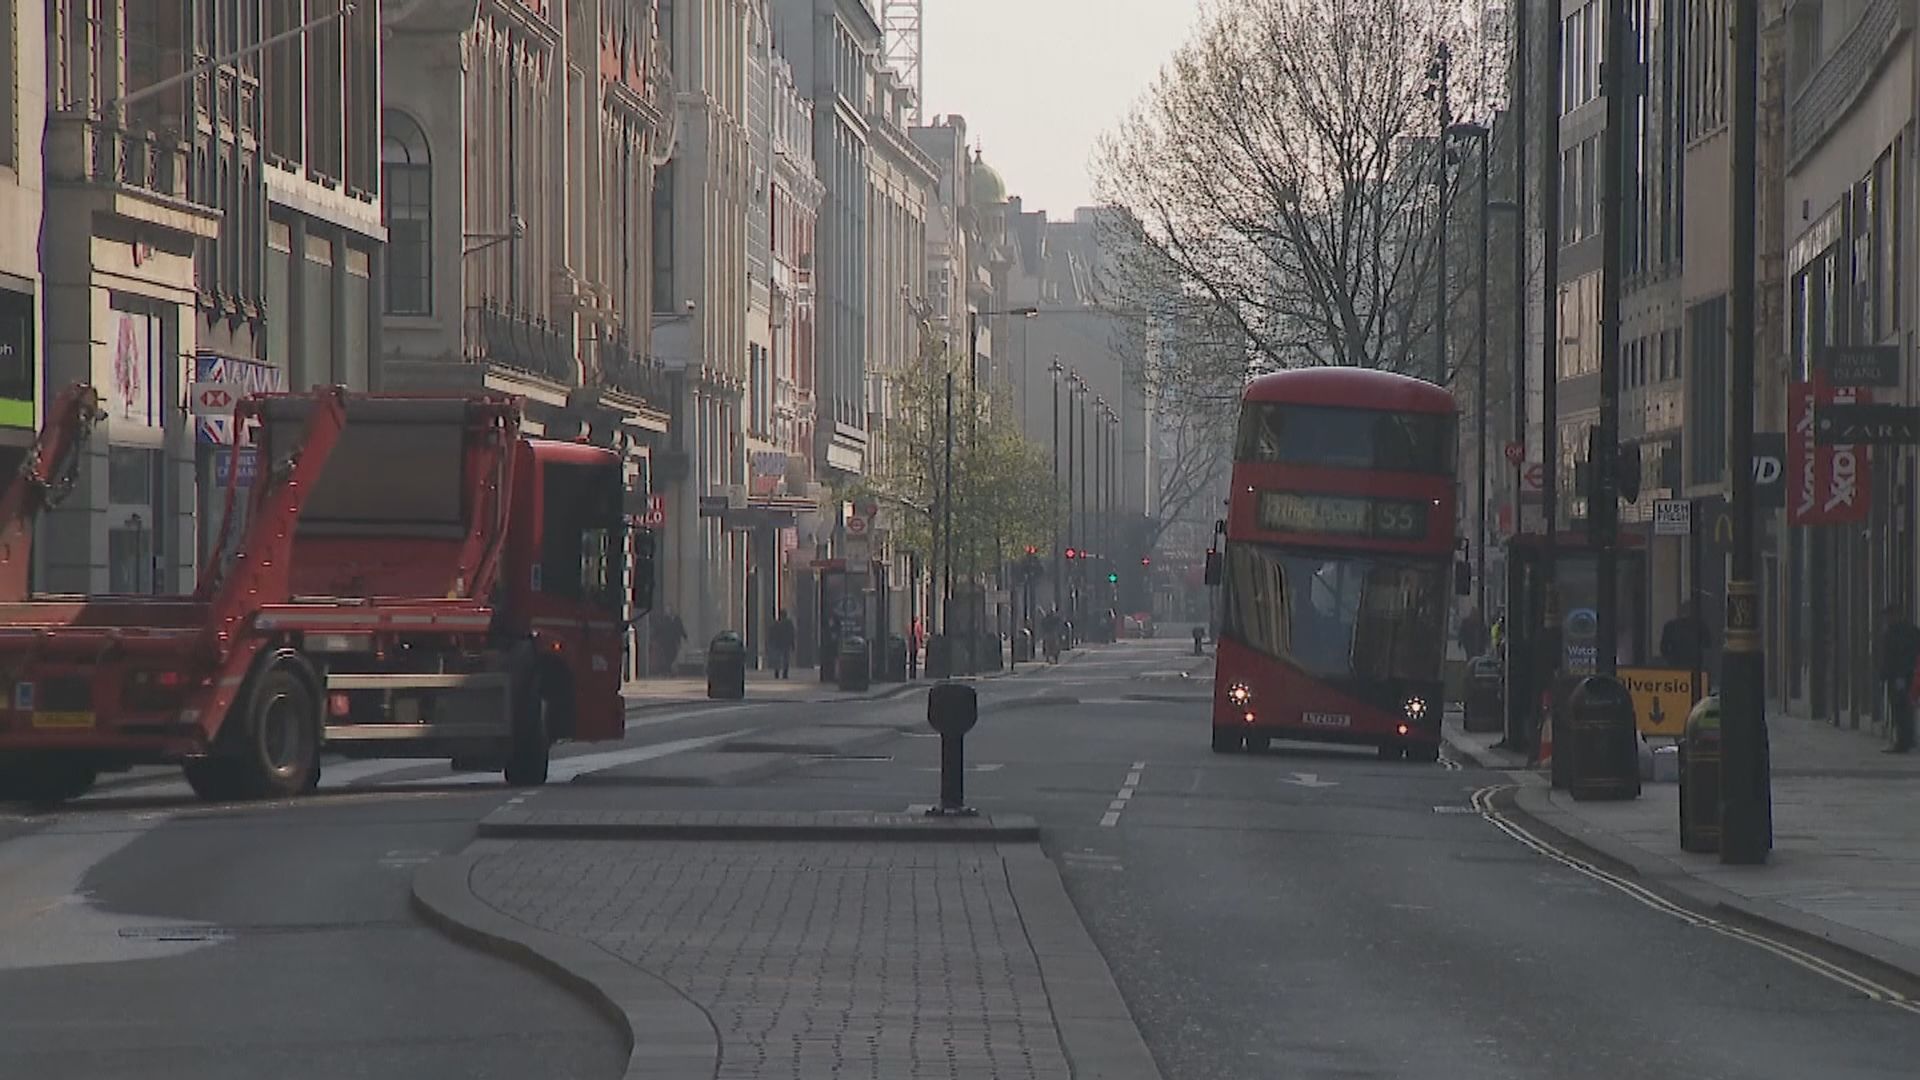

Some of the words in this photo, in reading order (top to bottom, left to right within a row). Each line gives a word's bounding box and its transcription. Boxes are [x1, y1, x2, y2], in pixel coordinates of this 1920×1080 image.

[1834, 368, 1882, 379] ISLAND
[1843, 425, 1911, 438] ZARA
[1657, 503, 1689, 513] LUSH
[1381, 504, 1415, 531] 55
[1624, 677, 1690, 694] iversio
